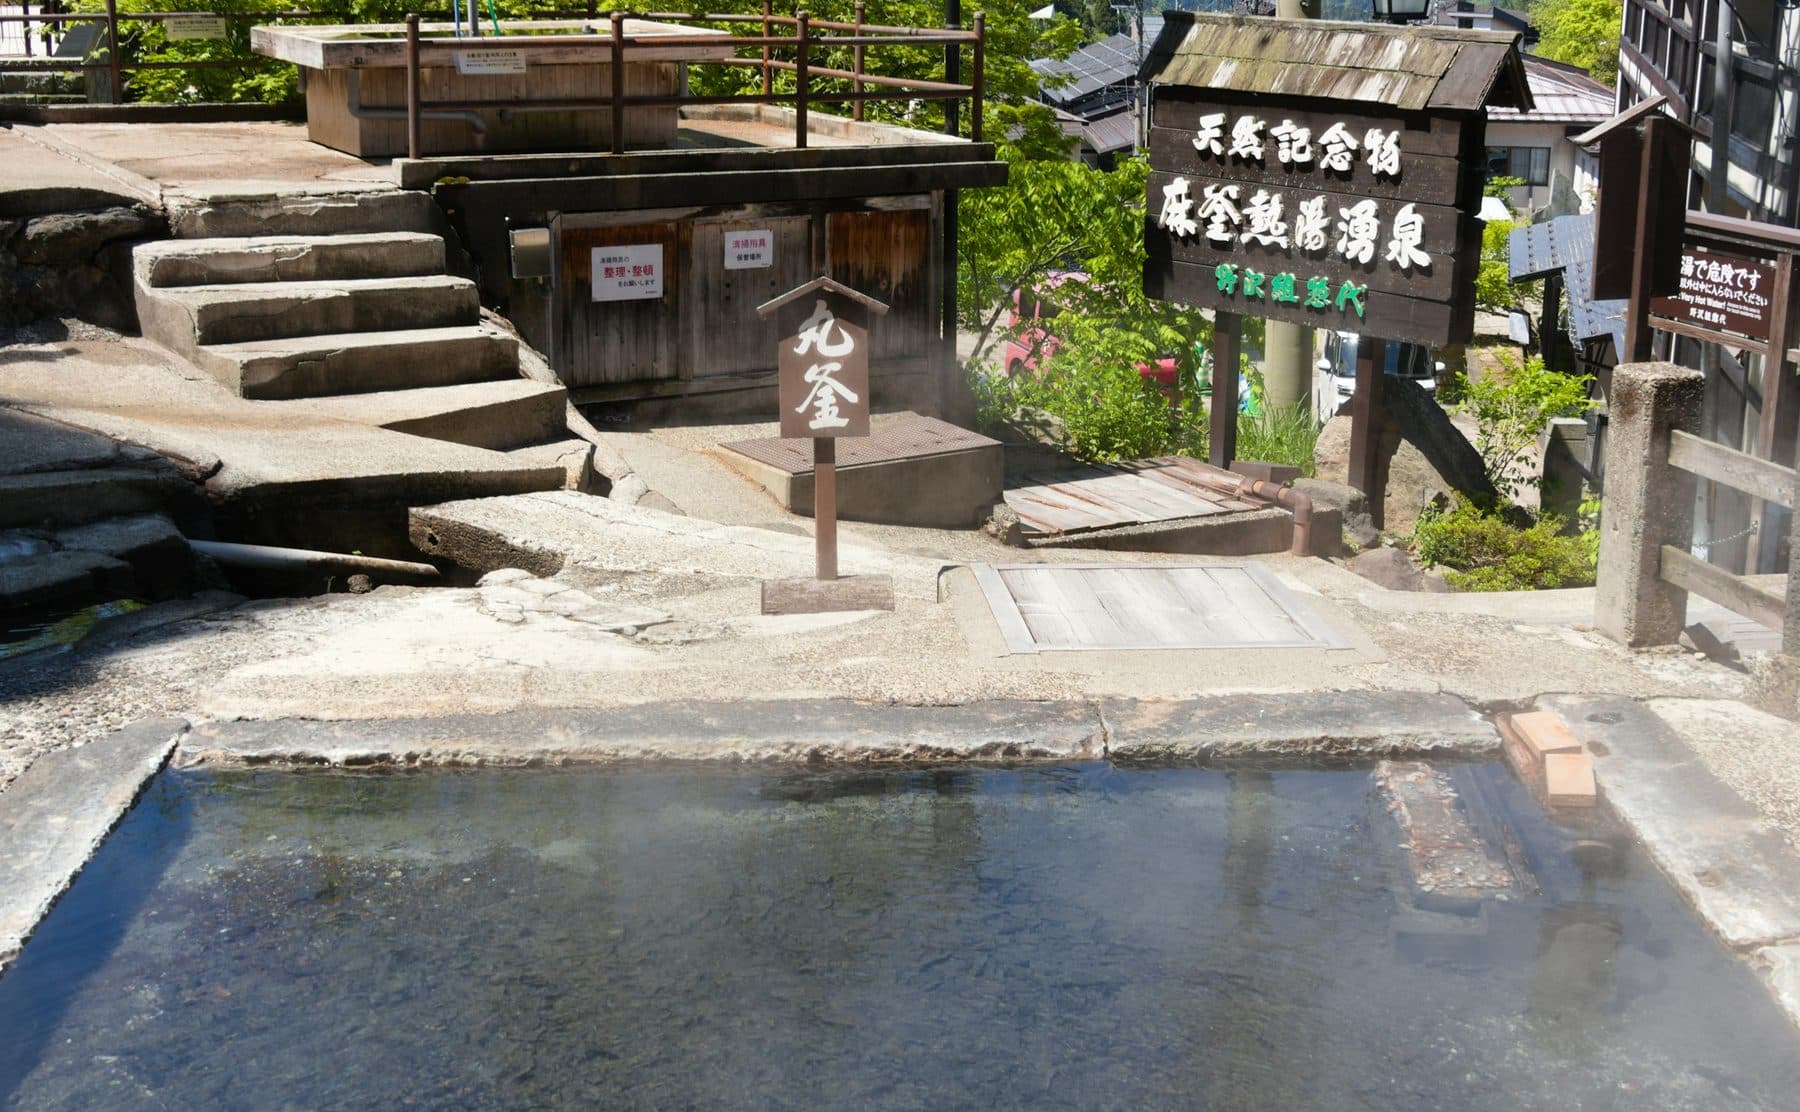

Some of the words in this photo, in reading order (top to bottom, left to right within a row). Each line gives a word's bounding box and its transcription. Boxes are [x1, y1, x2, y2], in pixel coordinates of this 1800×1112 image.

[1192, 112, 1401, 176] 天然記念物
[1158, 176, 1433, 269] 麻釜熱湯湧泉
[603, 263, 655, 279] 整理・整頓
[1215, 263, 1369, 318] 野沢組惣代
